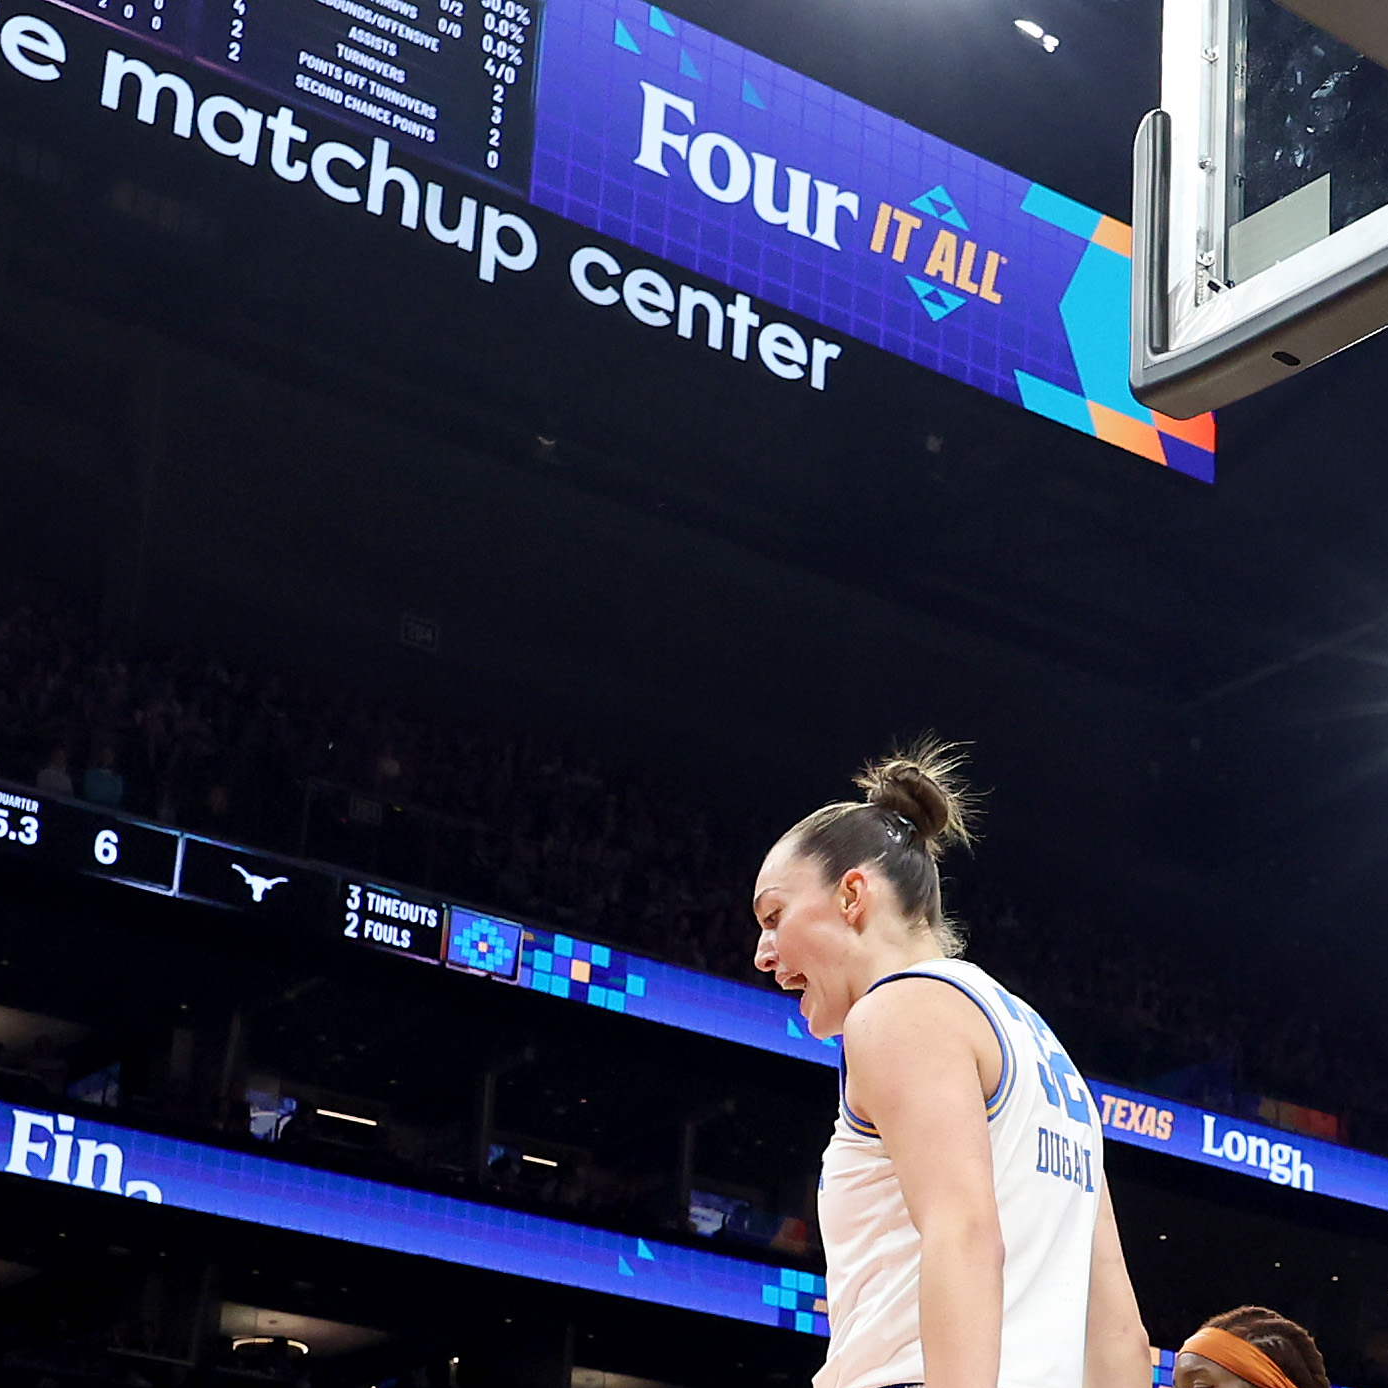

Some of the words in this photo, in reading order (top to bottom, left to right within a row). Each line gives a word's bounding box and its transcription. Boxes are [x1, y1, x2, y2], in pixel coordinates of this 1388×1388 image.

[123, 4, 134, 19] 0
[151, 15, 162, 30] 0
[438, 18, 462, 39] 0/0
[482, 34, 523, 65] 0.0%
[484, 13, 525, 44] 0.0%
[230, 19, 244, 38] 2
[298, 51, 343, 81] POINTS
[343, 70, 368, 91] OFF
[368, 79, 438, 120] TURNOVERS
[488, 128, 501, 148] 2
[336, 43, 406, 84] TURNOVERS
[491, 105, 503, 124] 3
[348, 26, 398, 57] ASSISTS
[493, 84, 505, 103] 2
[484, 57, 516, 84] 4/0
[227, 42, 240, 62] 2
[295, 74, 343, 105] SECOND
[344, 94, 392, 126] CHANCE
[392, 116, 437, 143] POINTS
[486, 150, 499, 169] 0
[100, 49, 539, 284] matchup
[569, 245, 842, 390] center
[633, 80, 859, 251] Four
[869, 202, 923, 263] IT
[924, 229, 1003, 304] ALL
[94, 829, 119, 865] 6
[344, 912, 360, 938] 2
[364, 919, 411, 949] FOULS
[346, 884, 362, 910] 3
[366, 892, 438, 928] TIMEOUTS
[1101, 1094, 1175, 1141] TEXAS
[1202, 1114, 1314, 1191] Longh
